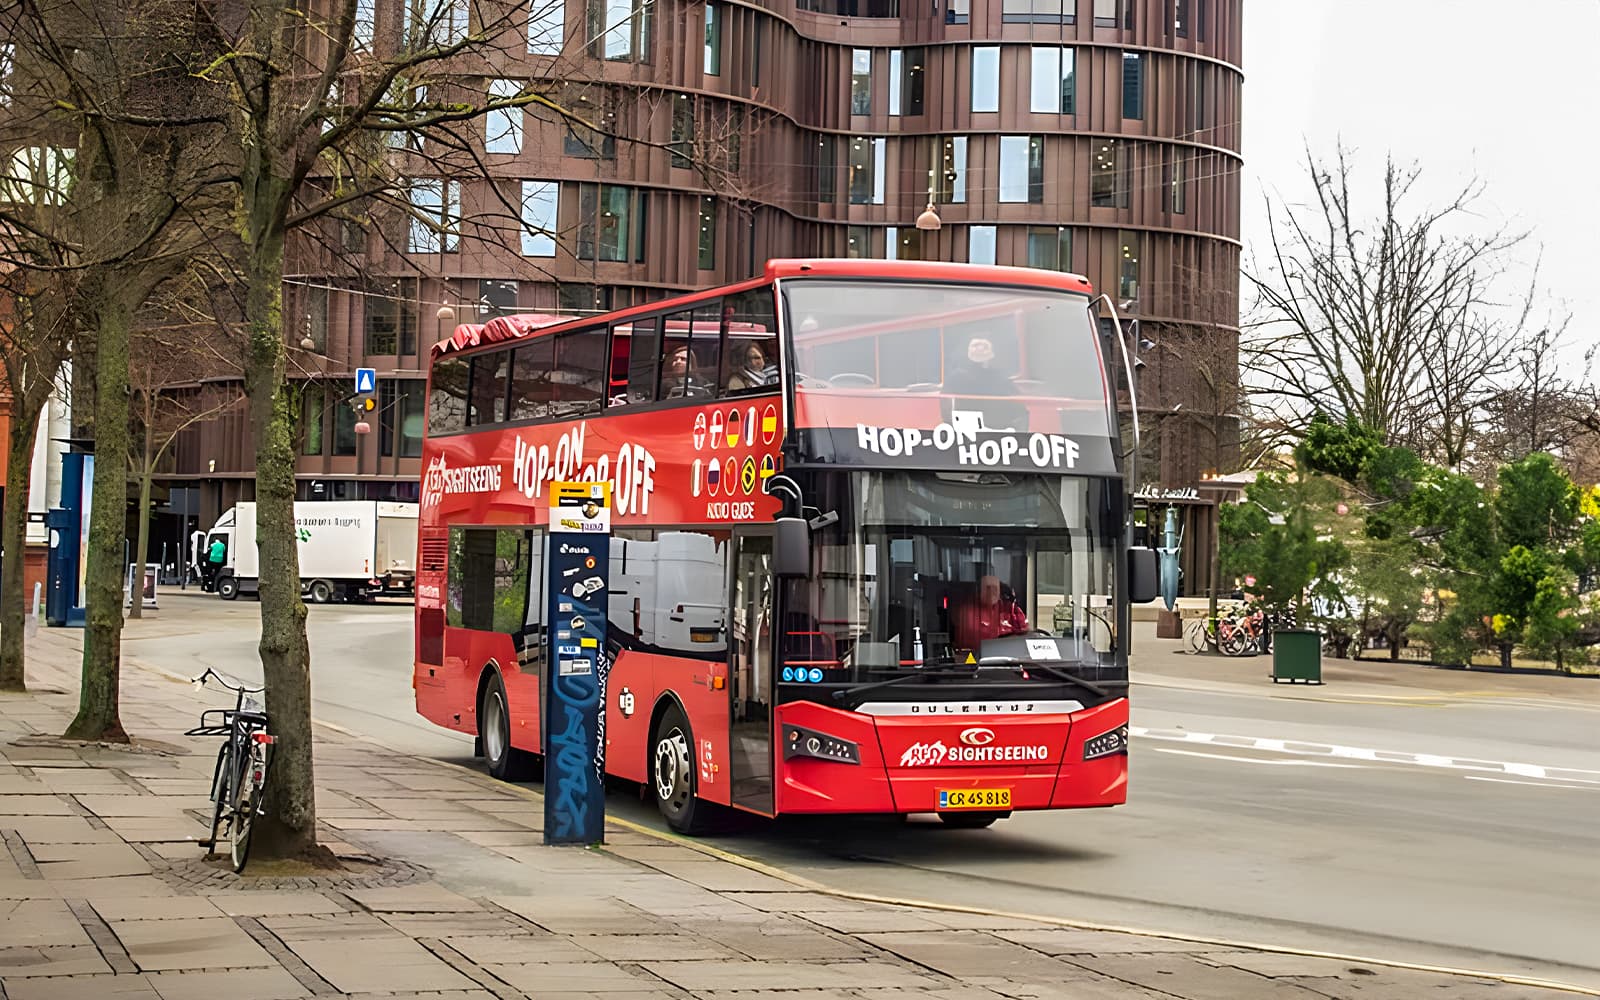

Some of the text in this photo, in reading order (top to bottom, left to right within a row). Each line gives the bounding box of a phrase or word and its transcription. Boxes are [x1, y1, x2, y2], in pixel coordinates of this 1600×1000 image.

[857, 422, 976, 457] HOP-ON
[958, 432, 1080, 468] HOP-OFF
[513, 420, 586, 499] HOP-ON
[948, 745, 1049, 762] SIGHTSEEING
